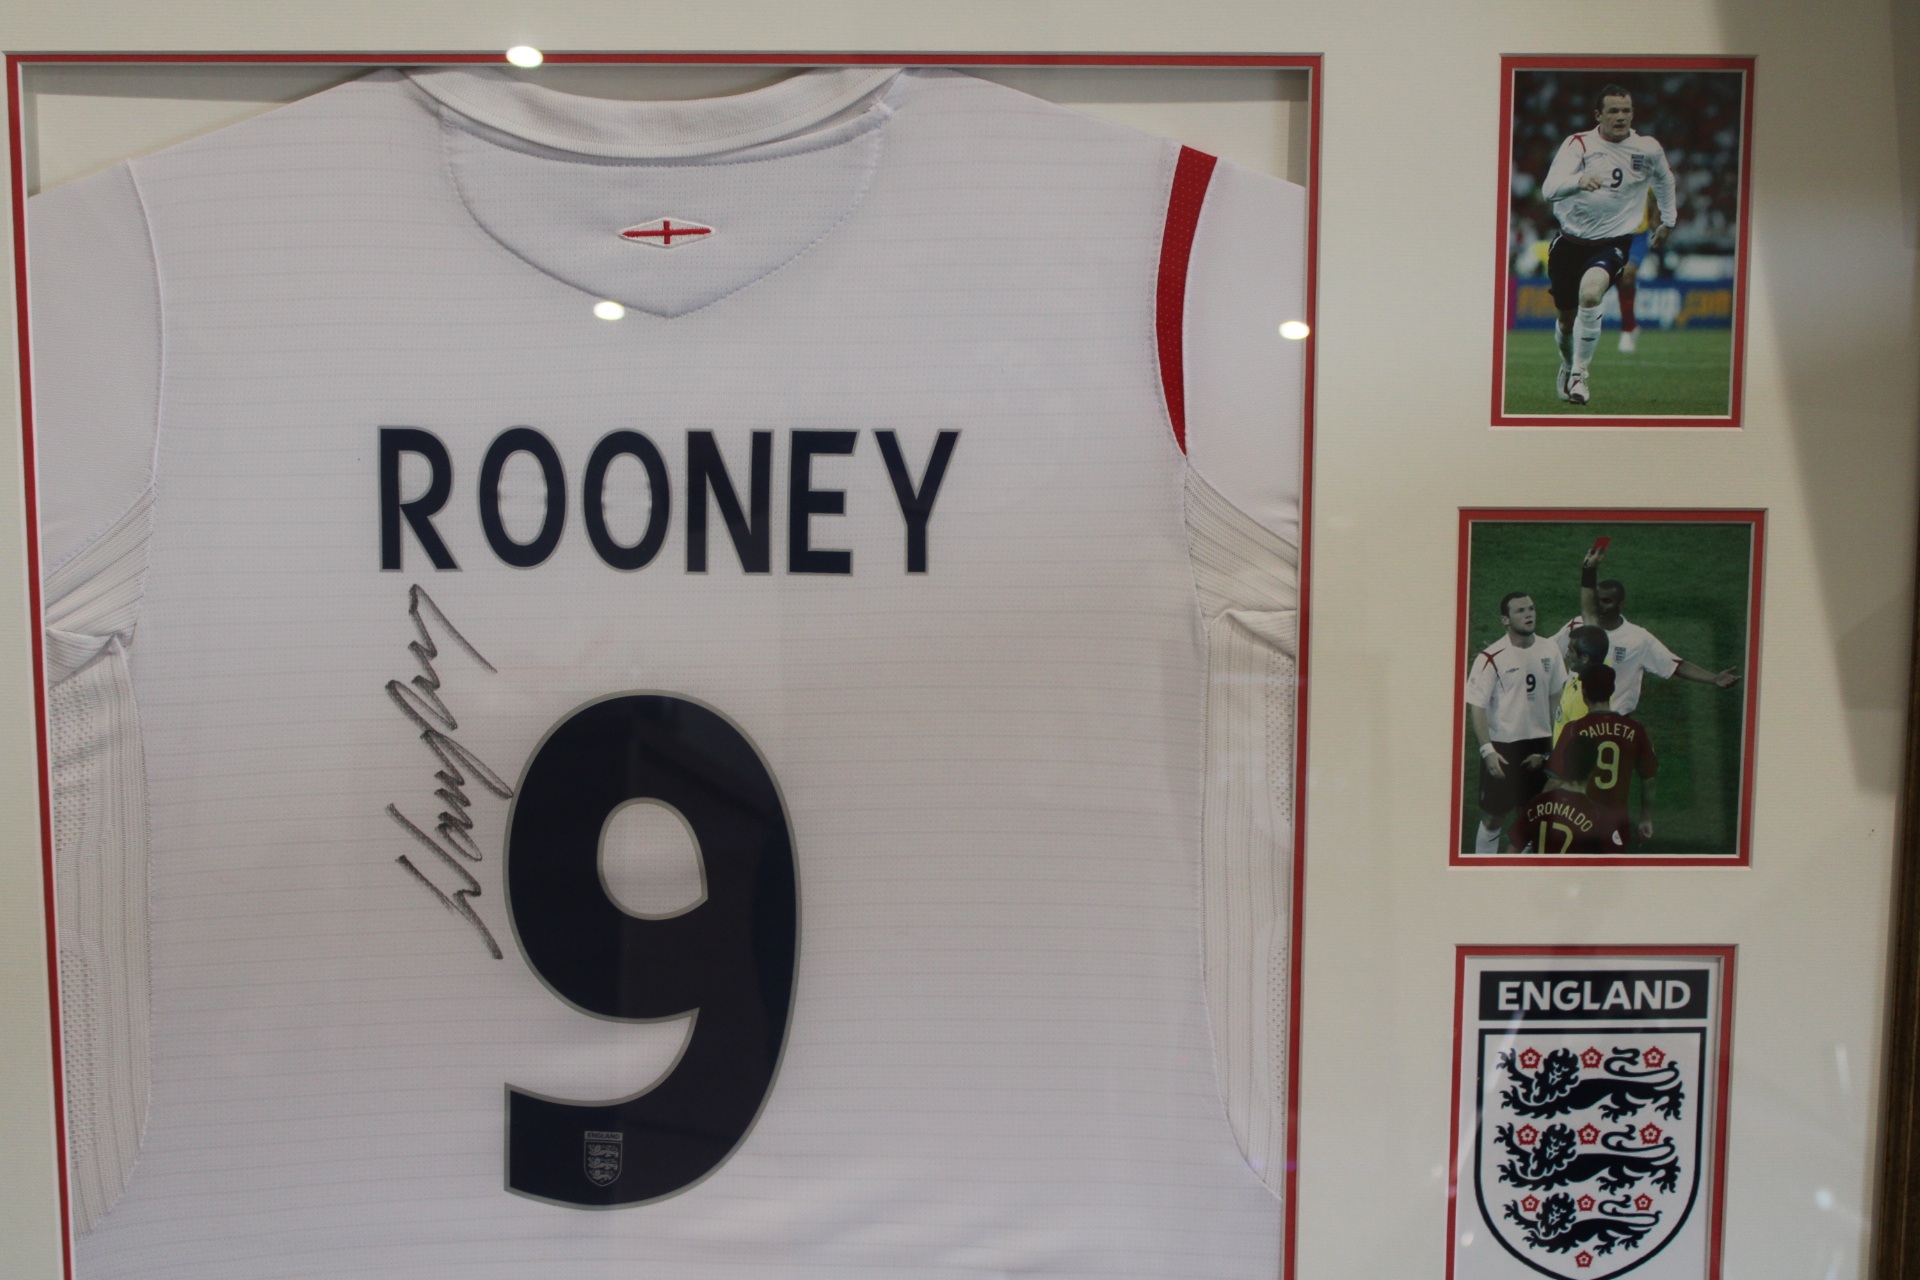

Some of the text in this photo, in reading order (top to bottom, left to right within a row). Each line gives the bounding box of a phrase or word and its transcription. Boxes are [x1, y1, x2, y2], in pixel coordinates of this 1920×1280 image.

[1610, 168, 1623, 188] 9
[377, 426, 962, 577] ROONEY
[1526, 673, 1536, 692] 9
[1594, 741, 1620, 790] 9
[1527, 801, 1593, 832] C.RONALDO
[503, 689, 800, 1212] 9
[1497, 979, 1691, 1012] ENGLAND
